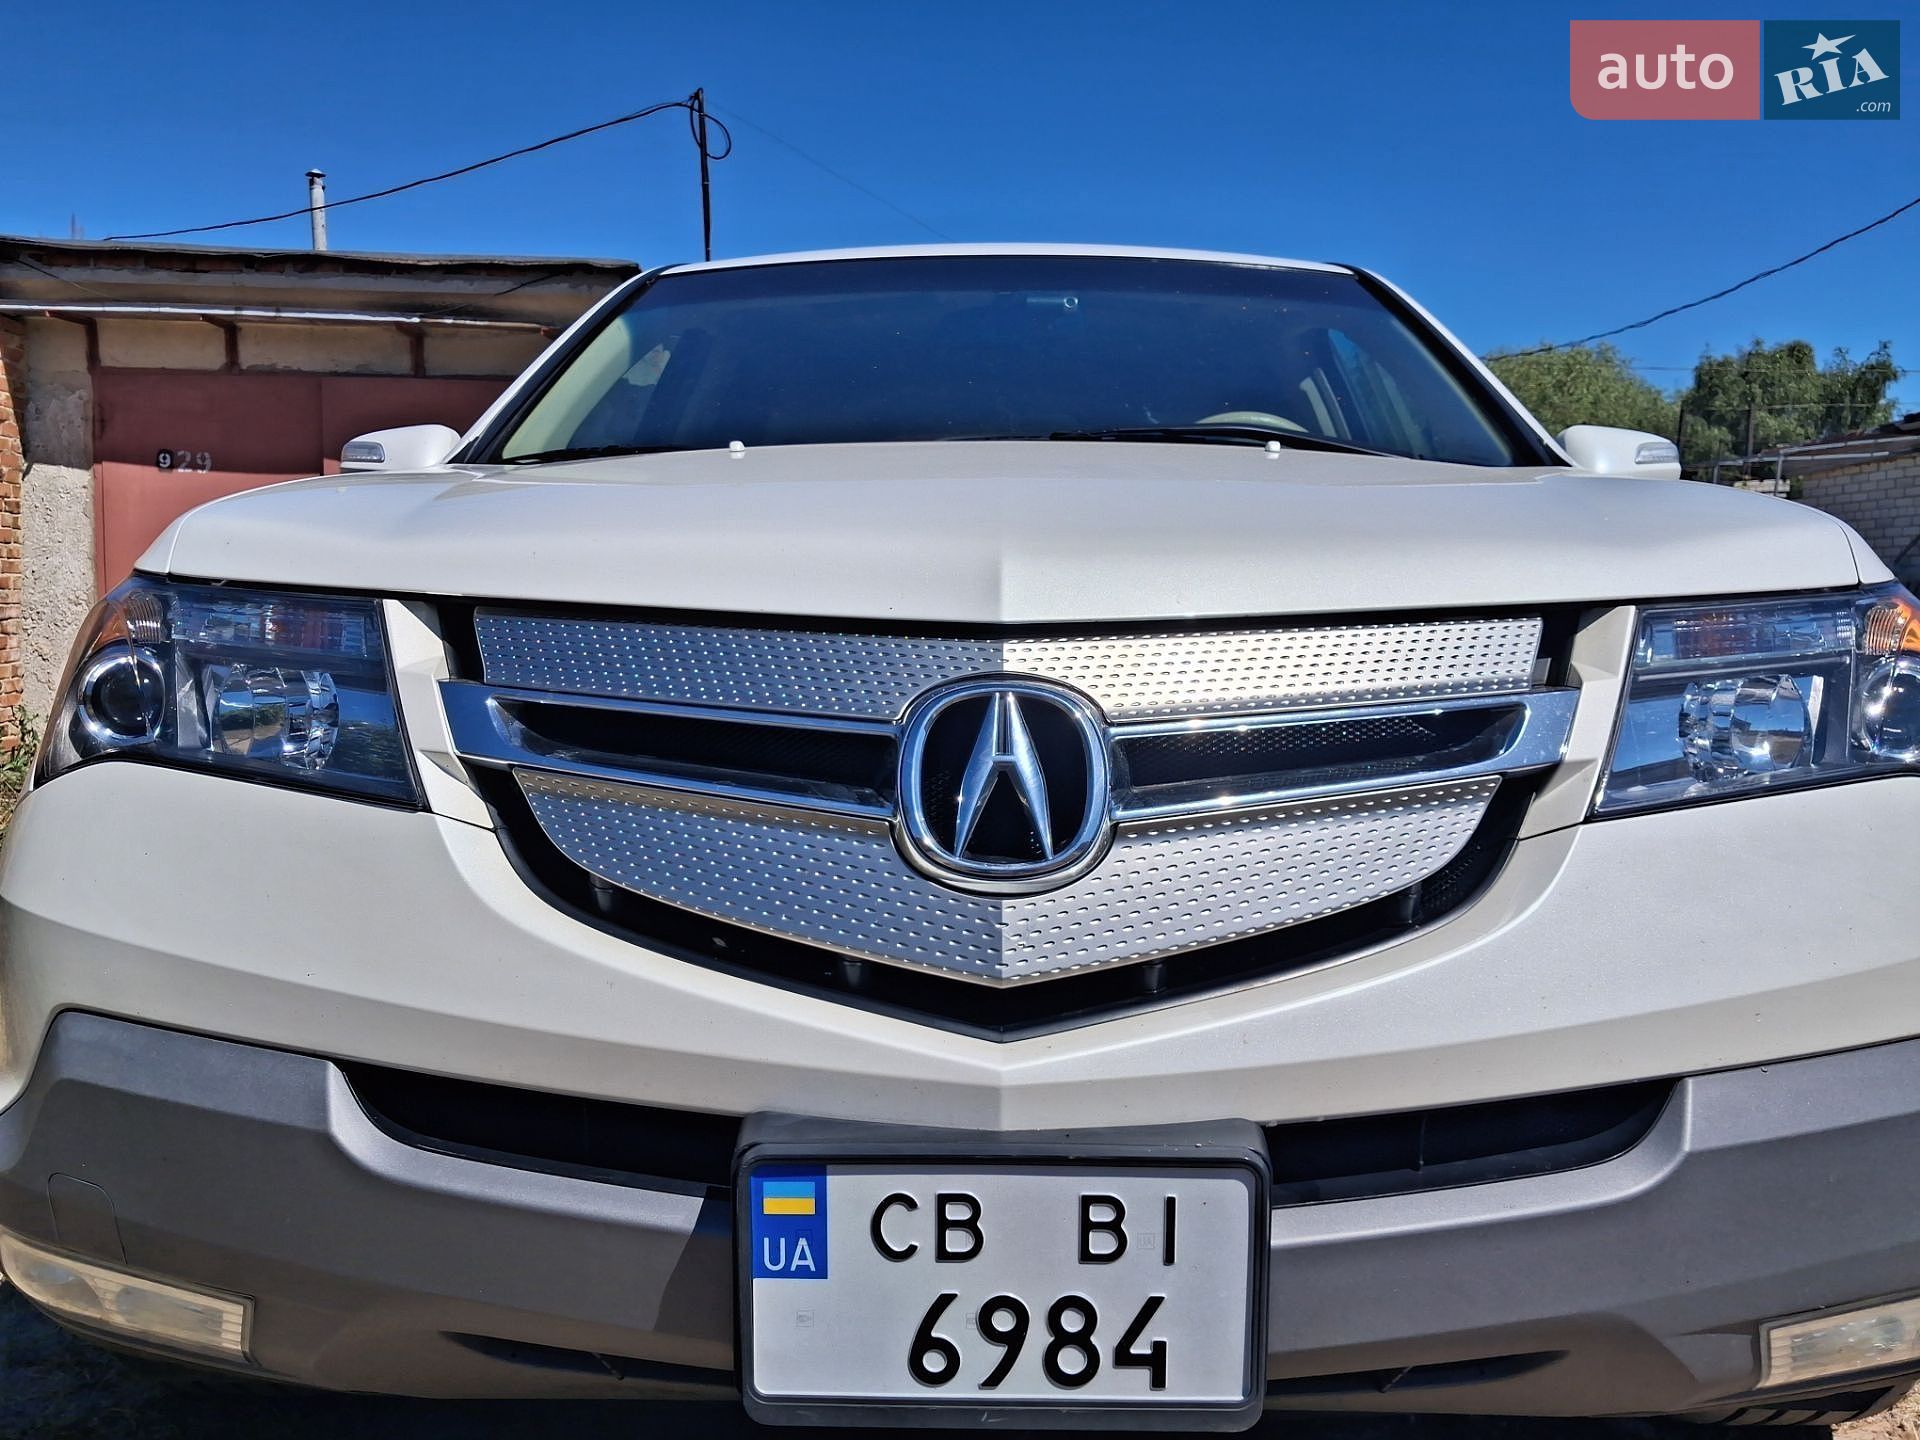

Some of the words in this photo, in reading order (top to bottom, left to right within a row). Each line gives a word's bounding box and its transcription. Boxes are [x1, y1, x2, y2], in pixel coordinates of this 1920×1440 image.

[158, 450, 212, 474] 929
[763, 1237, 816, 1271] UA
[870, 1193, 984, 1263] CB
[1078, 1193, 1177, 1265] BI
[907, 1292, 1168, 1391] 6984
